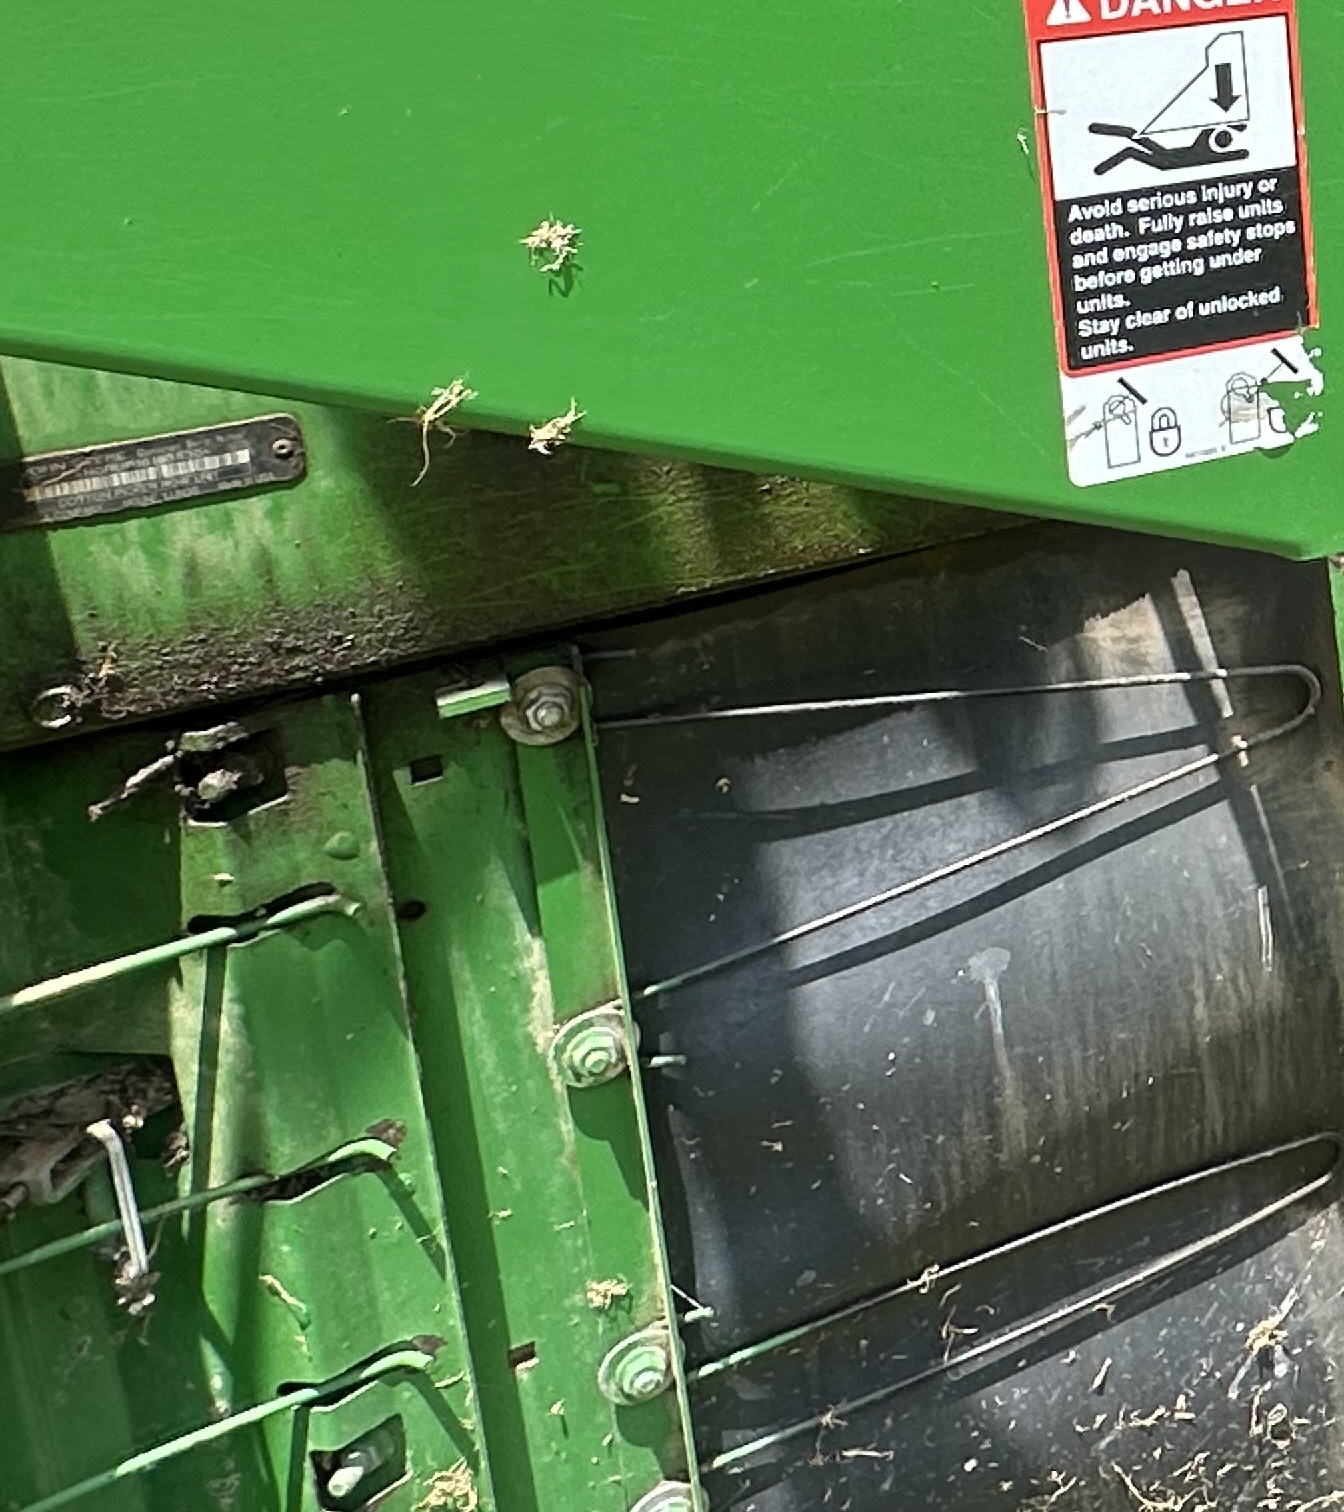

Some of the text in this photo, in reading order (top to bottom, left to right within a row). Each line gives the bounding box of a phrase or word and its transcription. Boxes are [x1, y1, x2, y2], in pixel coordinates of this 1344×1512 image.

[1068, 177, 1278, 223] Avoid serious injury or
[1069, 198, 1285, 245] death. Fully raise units
[1072, 220, 1297, 269] and engage safety stops
[1073, 247, 1263, 292] before getting under
[1076, 292, 1131, 314] units.
[1078, 285, 1282, 338] Stay clear of unlocked
[1080, 337, 1135, 360] units.
